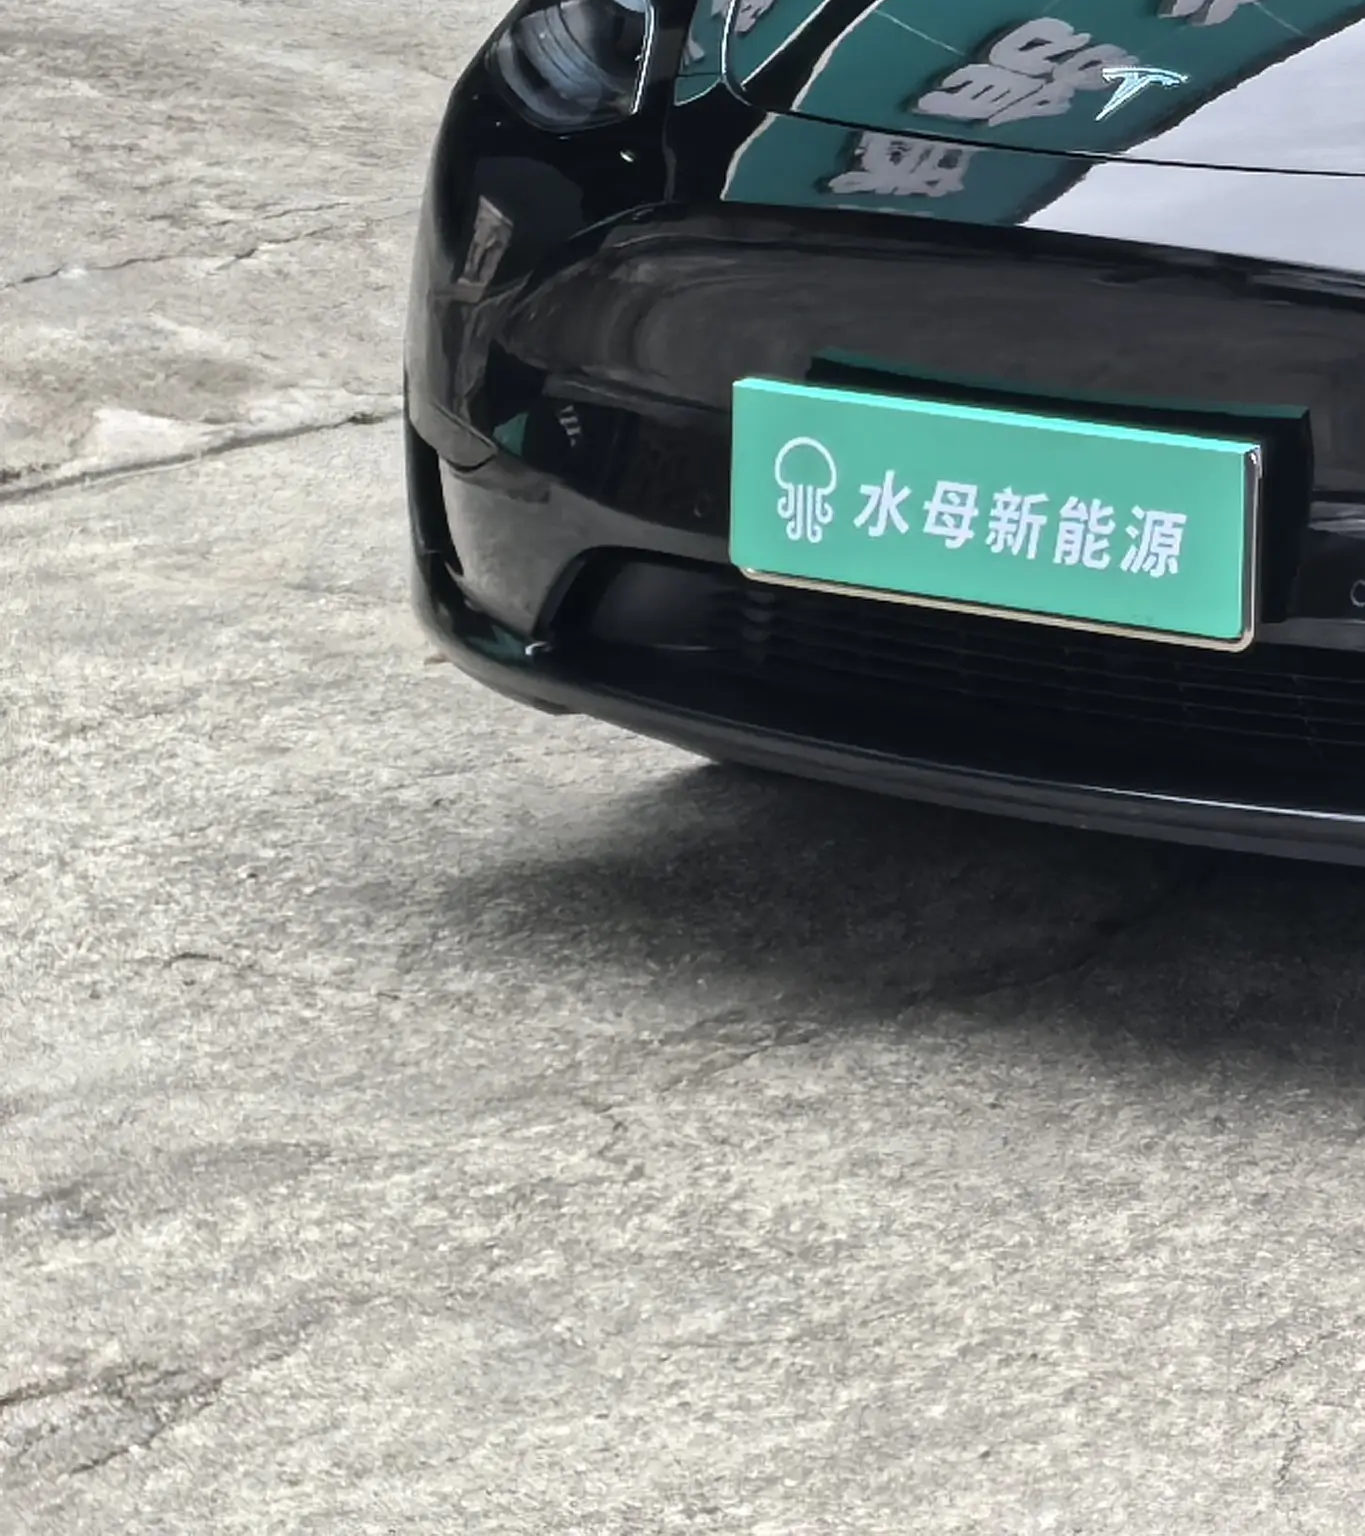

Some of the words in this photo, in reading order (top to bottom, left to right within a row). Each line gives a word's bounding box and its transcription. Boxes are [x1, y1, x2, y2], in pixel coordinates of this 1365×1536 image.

[853, 469, 1188, 579] 水母新能源
